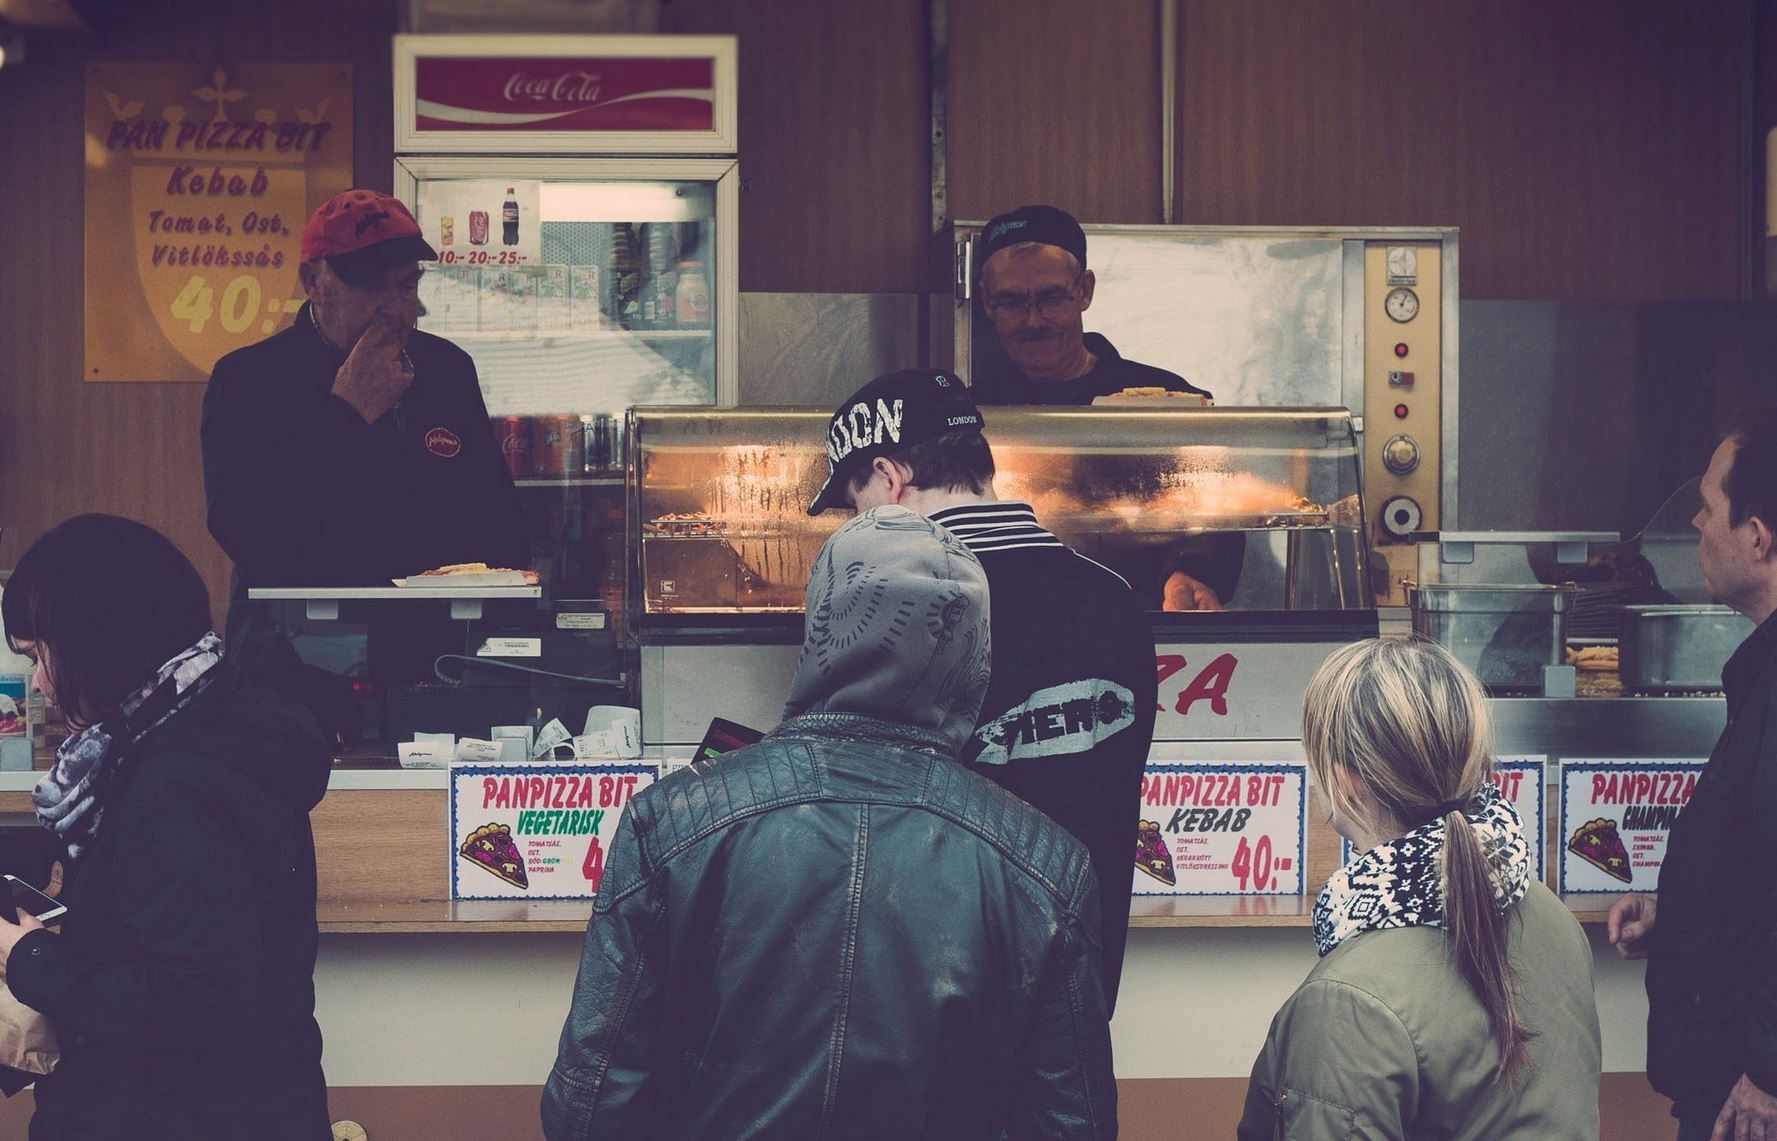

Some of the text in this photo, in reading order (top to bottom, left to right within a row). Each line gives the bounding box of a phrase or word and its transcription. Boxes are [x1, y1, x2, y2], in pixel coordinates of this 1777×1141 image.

[107, 120, 331, 151] PAN PIZZA BIT
[166, 167, 269, 196] Kebab
[149, 211, 290, 236] Tomat, Ost,
[826, 398, 904, 463] DON
[947, 415, 978, 427] LONDON
[483, 777, 638, 809] PANPIZZA BIT
[1247, 775, 1285, 807] BIT
[1591, 773, 1695, 805] PANPIZZA
[517, 810, 604, 836] VEGETARISK
[1165, 808, 1251, 834] KEBAB
[1231, 834, 1292, 891] 40:-
